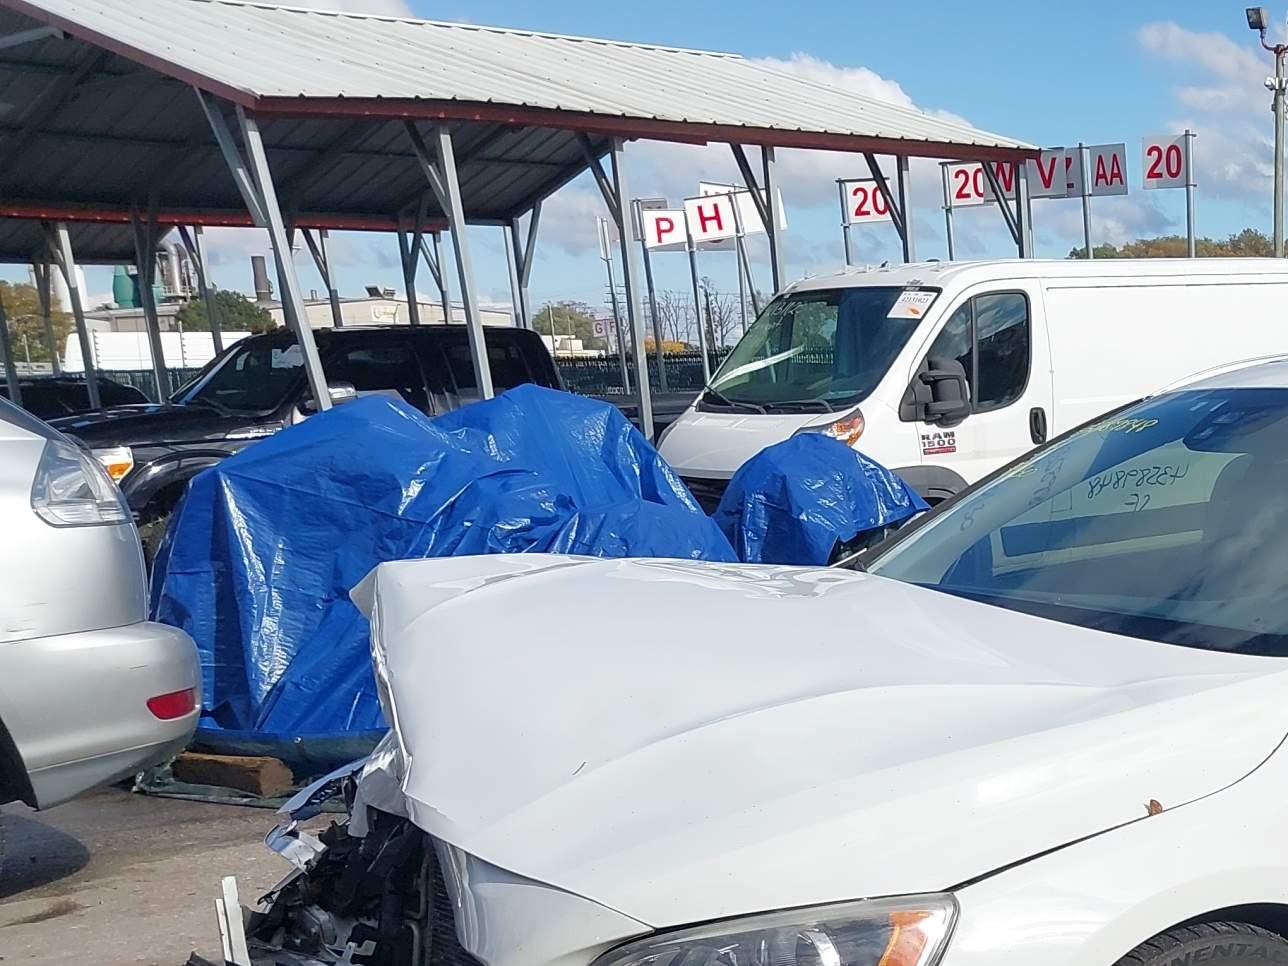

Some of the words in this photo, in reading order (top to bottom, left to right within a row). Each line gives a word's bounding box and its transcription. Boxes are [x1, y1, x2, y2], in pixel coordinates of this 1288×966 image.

[1095, 153, 1124, 187] AA
[1146, 144, 1182, 180] 20
[852, 187, 889, 217] 20
[655, 217, 675, 243] P
[697, 203, 724, 232] H
[921, 431, 955, 440] RAM
[922, 438, 956, 447] 1500
